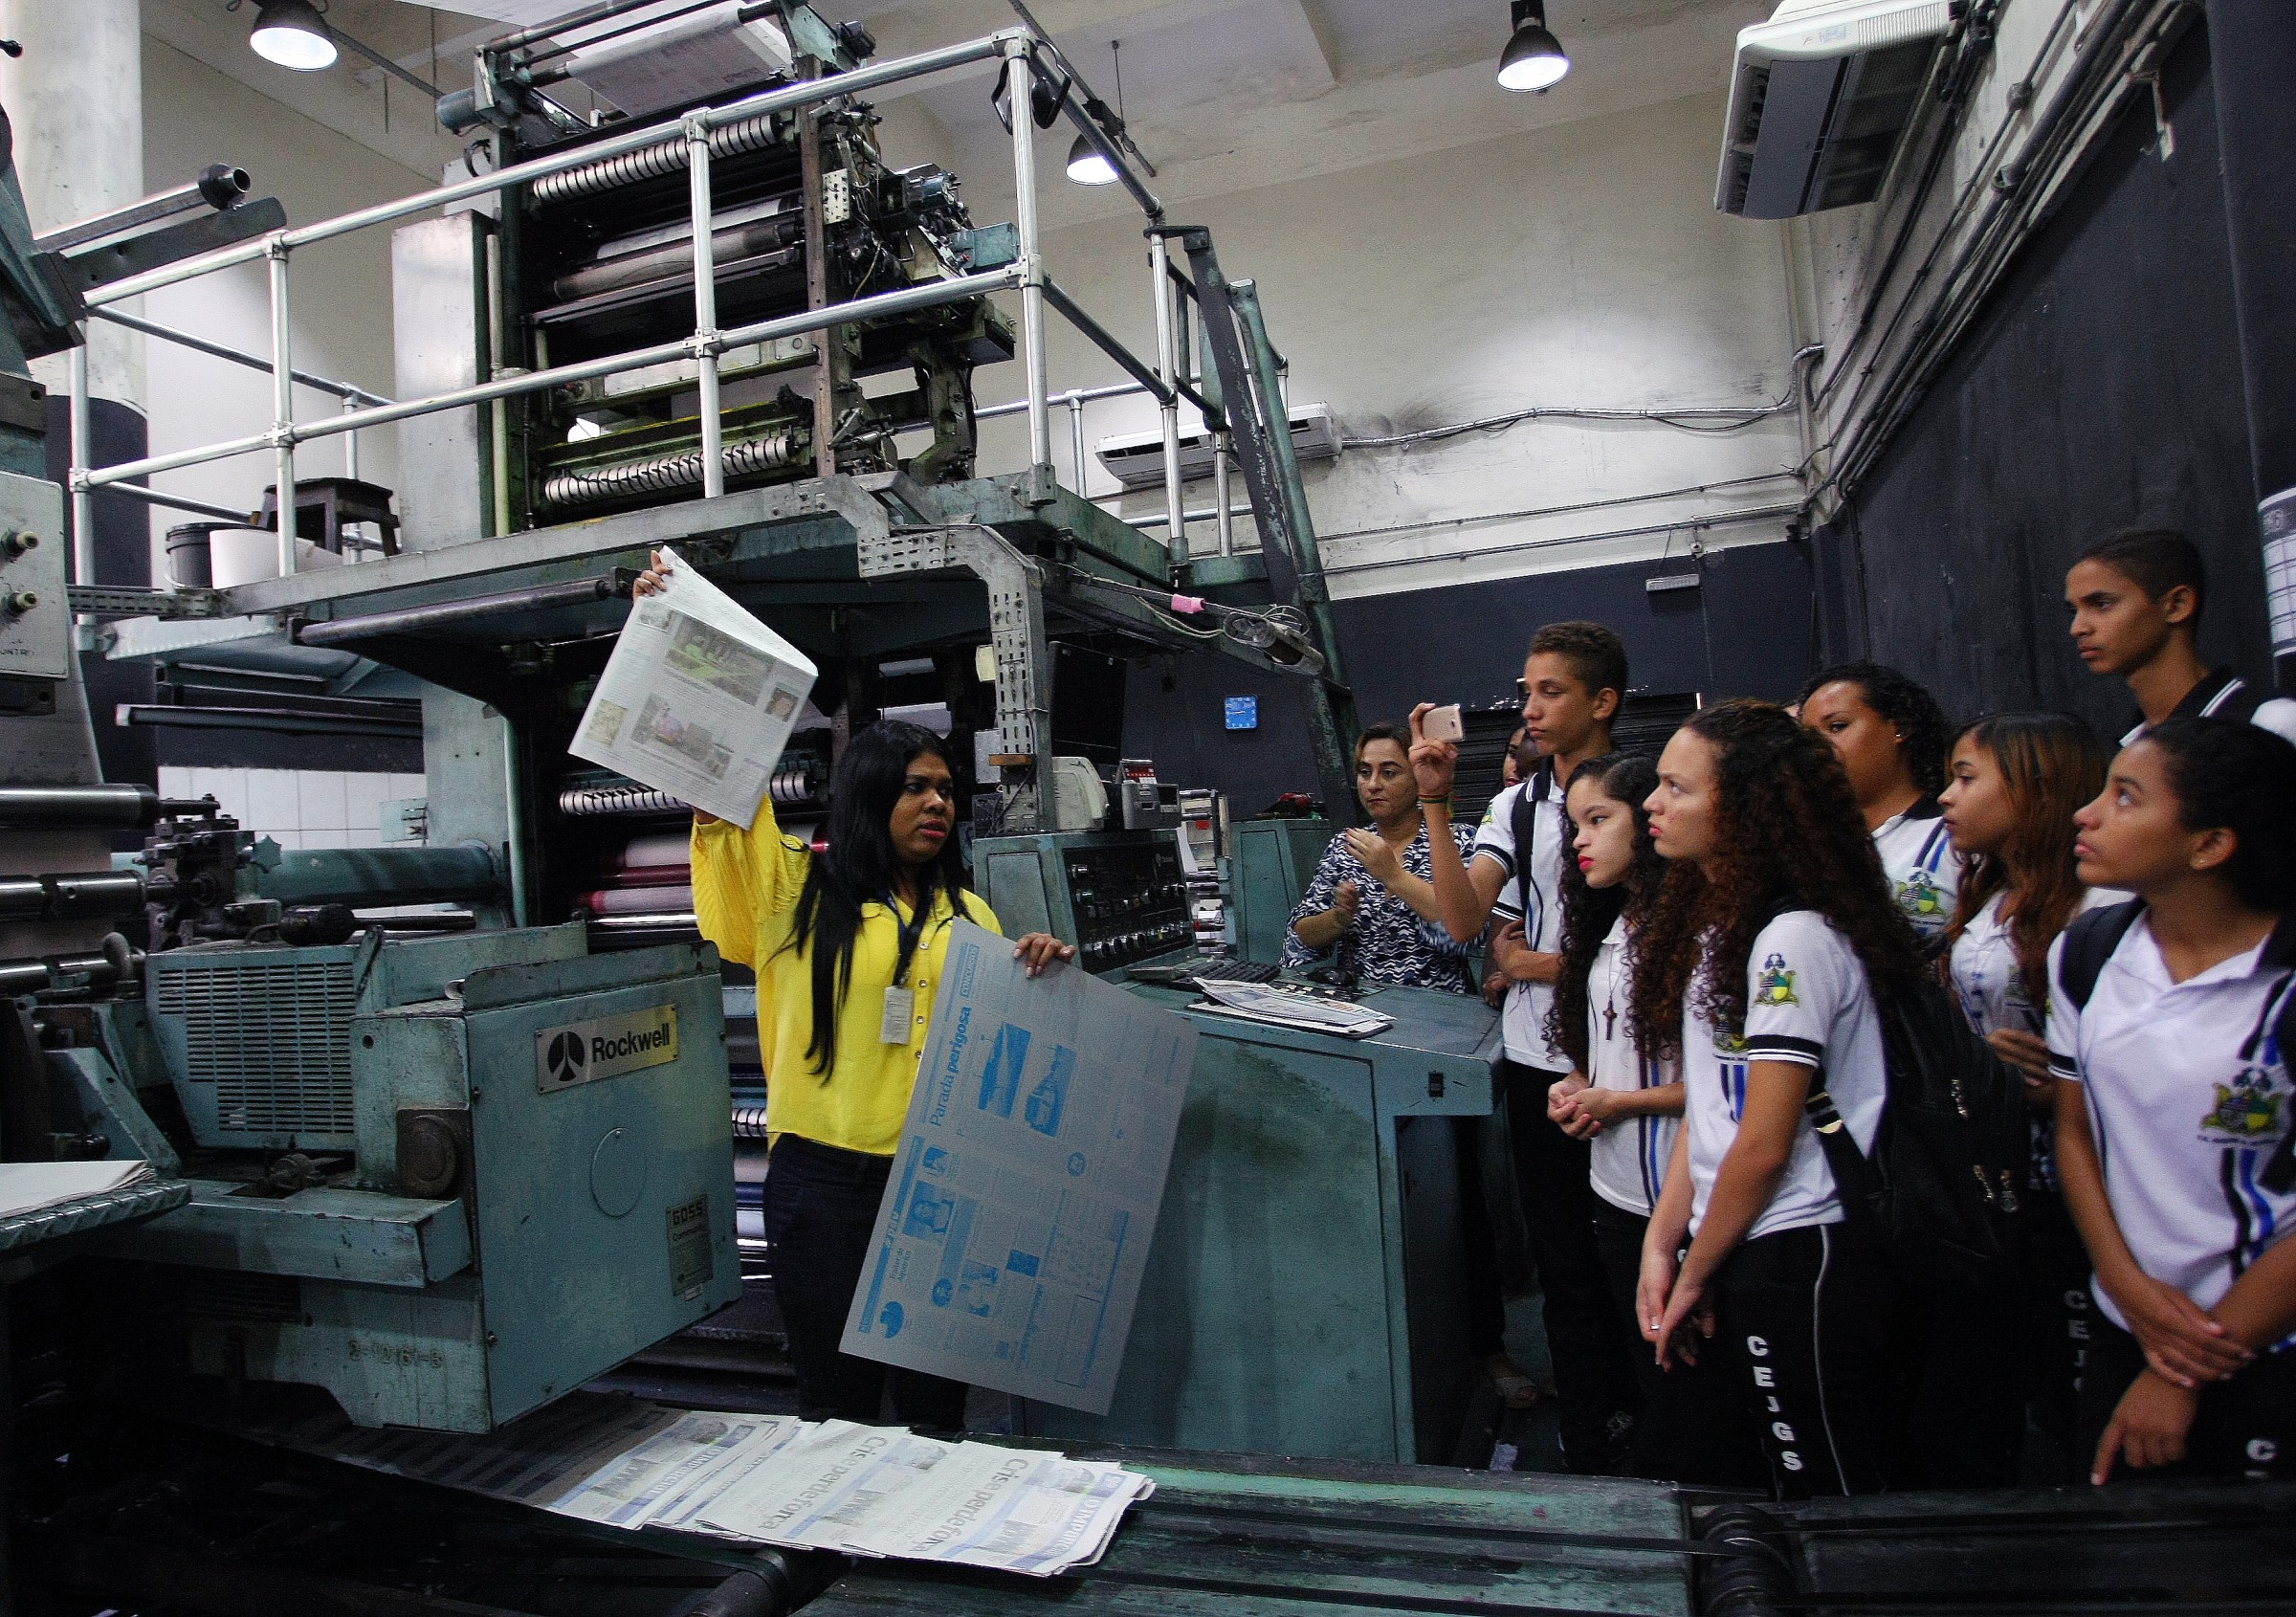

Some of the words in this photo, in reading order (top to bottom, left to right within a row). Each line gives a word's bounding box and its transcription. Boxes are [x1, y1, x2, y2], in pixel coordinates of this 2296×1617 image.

[591, 1023, 671, 1063] Rockwell
[928, 1072, 955, 1128] Parada
[944, 1005, 975, 1074] perigosa
[673, 1200, 705, 1226] GOSS
[1747, 1336, 1802, 1471] CEJGS
[836, 1435, 894, 1468] Crise
[796, 1464, 855, 1500] perde
[981, 1457, 1035, 1492] Crise
[755, 1496, 816, 1533] força
[942, 1489, 998, 1528] perde
